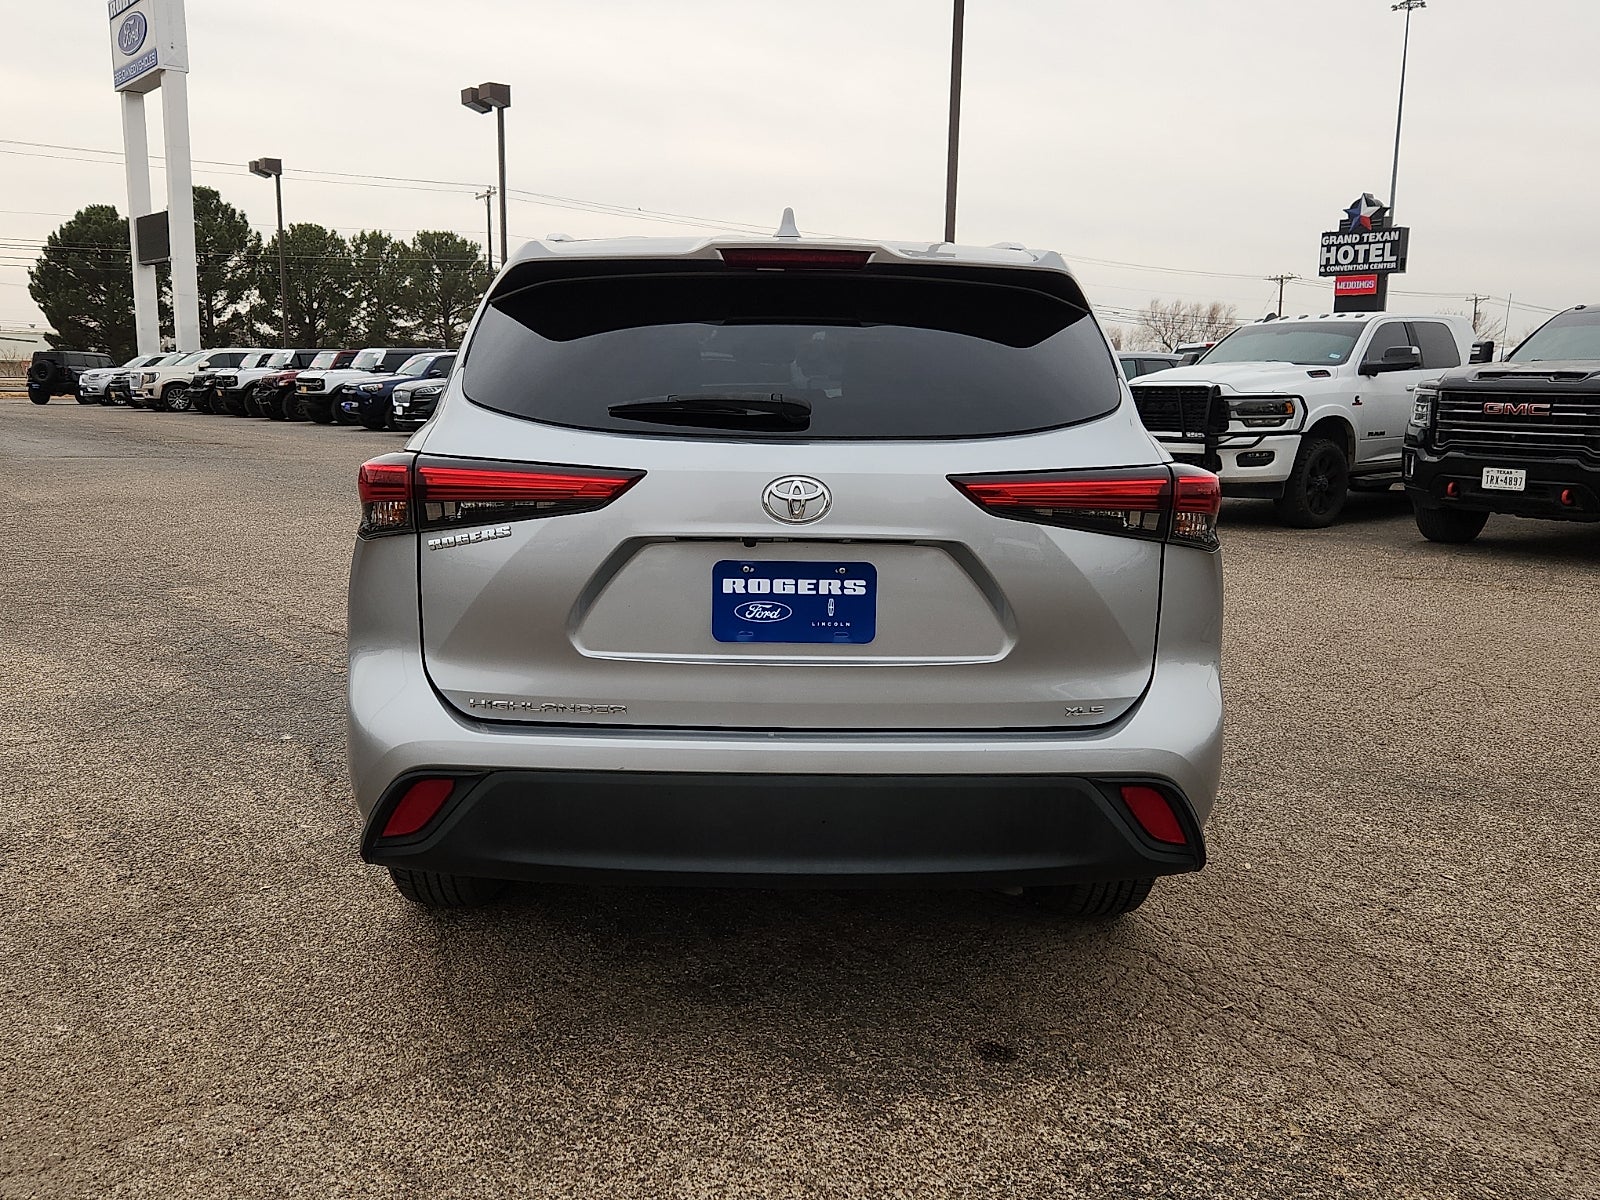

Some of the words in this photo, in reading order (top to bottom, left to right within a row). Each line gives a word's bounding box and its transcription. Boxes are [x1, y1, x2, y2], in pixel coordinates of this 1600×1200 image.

[1322, 233, 1360, 246] GRAND
[1362, 231, 1400, 242] TEXAN
[1320, 242, 1397, 265] HOTEL
[1326, 263, 1369, 272] CONVENTION
[1369, 262, 1397, 270] CENTER
[1336, 280, 1375, 290] WEDDINGS
[1483, 402, 1551, 417] GMC
[428, 525, 512, 551] ROGERS
[722, 578, 867, 596] ROGERS
[745, 603, 782, 620] Ford
[469, 698, 627, 715] HIGHLANDER
[1064, 705, 1105, 717] XLE
